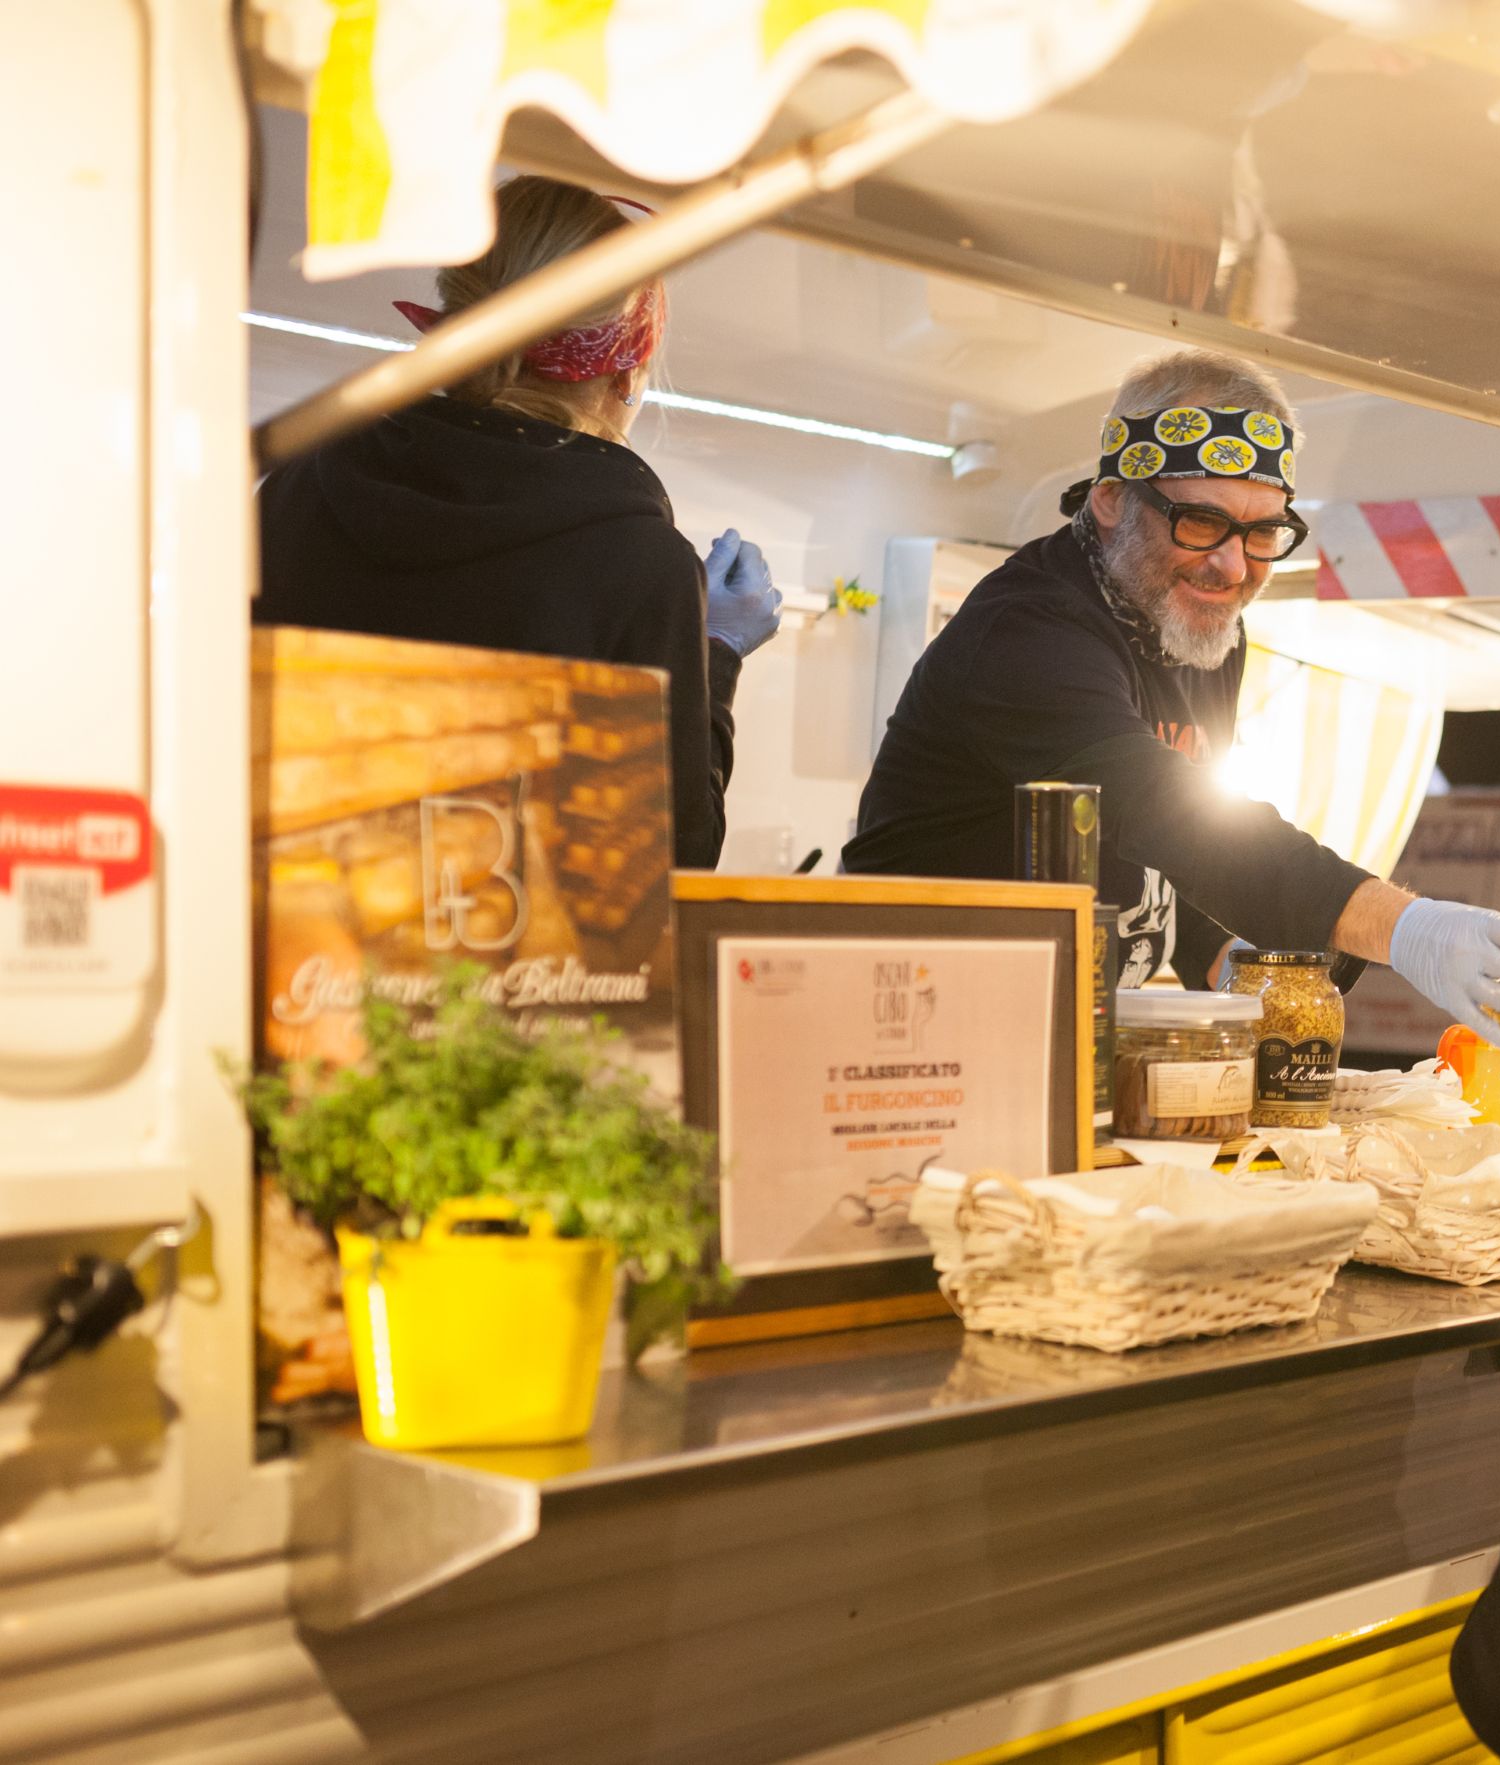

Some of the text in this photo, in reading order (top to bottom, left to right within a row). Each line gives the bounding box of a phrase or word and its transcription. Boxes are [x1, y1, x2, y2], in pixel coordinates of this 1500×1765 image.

[1257, 953, 1298, 966] MAILLE
[503, 953, 653, 1009] Beltrami
[842, 1061, 963, 1082] CLASSIFICATO
[822, 1086, 966, 1114] IL FURGONCINO
